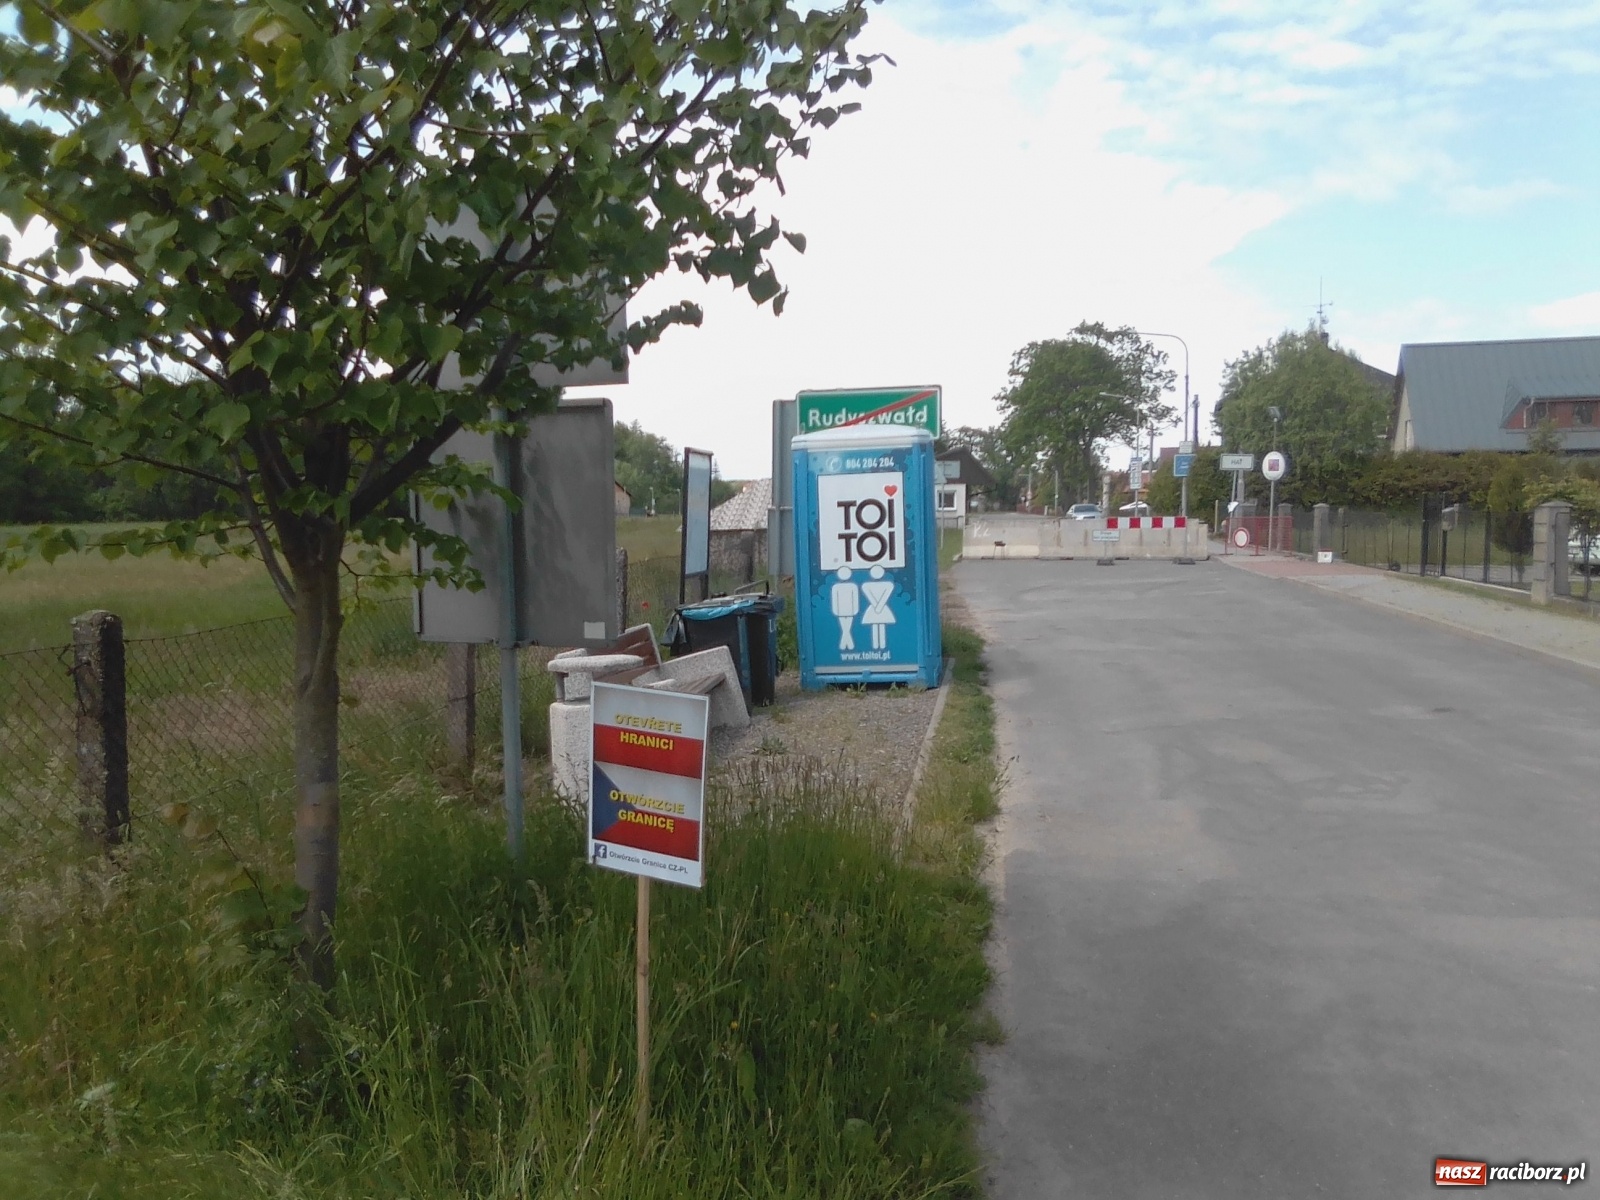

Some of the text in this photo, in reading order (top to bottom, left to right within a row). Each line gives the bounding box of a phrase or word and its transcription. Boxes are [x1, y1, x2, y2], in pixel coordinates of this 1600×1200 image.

[837, 498, 895, 530] TOI
[838, 530, 896, 562] TOI
[614, 712, 683, 734] OTEVŘETE
[619, 731, 674, 751] HRANICI
[609, 789, 685, 815] OTWÓRZCIE
[618, 809, 675, 833] GRANICĘ
[667, 863, 688, 875] CZ-PL
